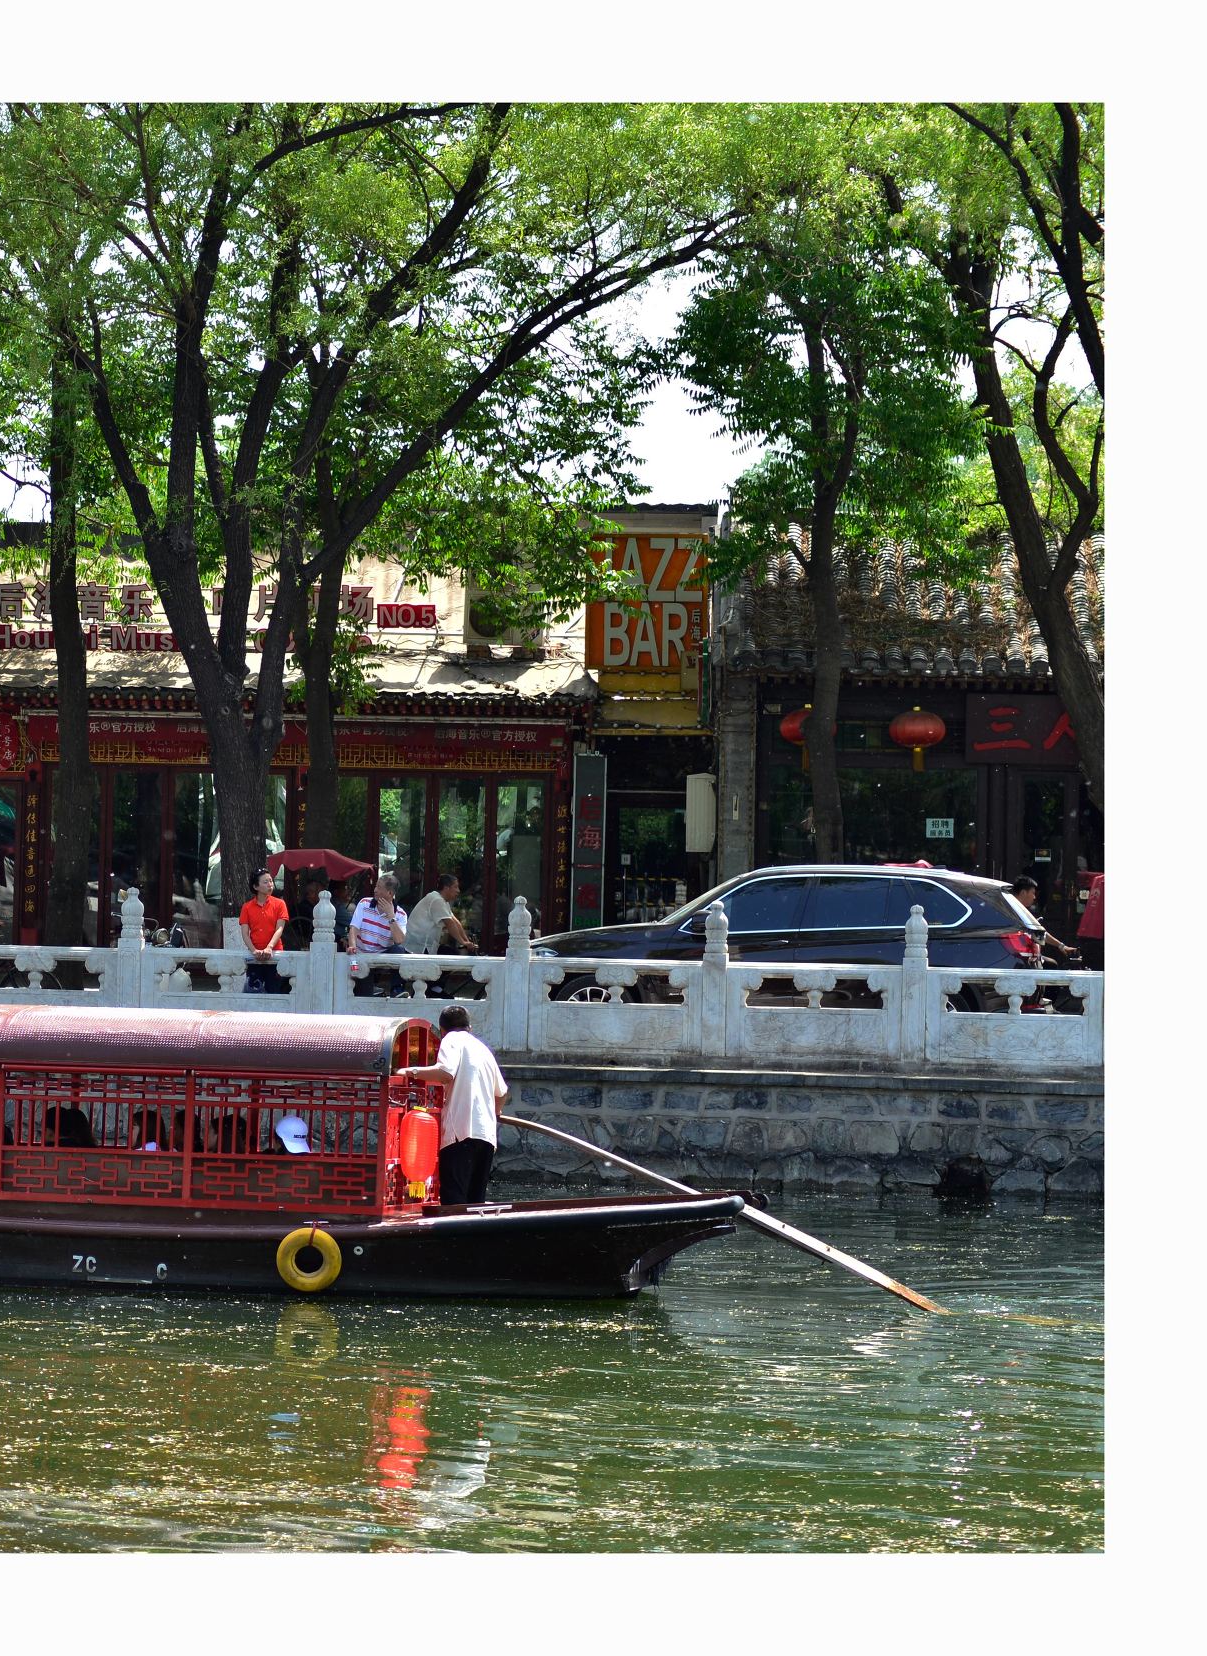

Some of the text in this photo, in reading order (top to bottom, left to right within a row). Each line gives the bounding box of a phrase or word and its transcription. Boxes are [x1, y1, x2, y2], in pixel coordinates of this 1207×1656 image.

[379, 605, 435, 628] NO.5
[111, 625, 181, 651] Mus
[603, 601, 691, 667] BAR
[72, 1255, 168, 1280] ZC C
